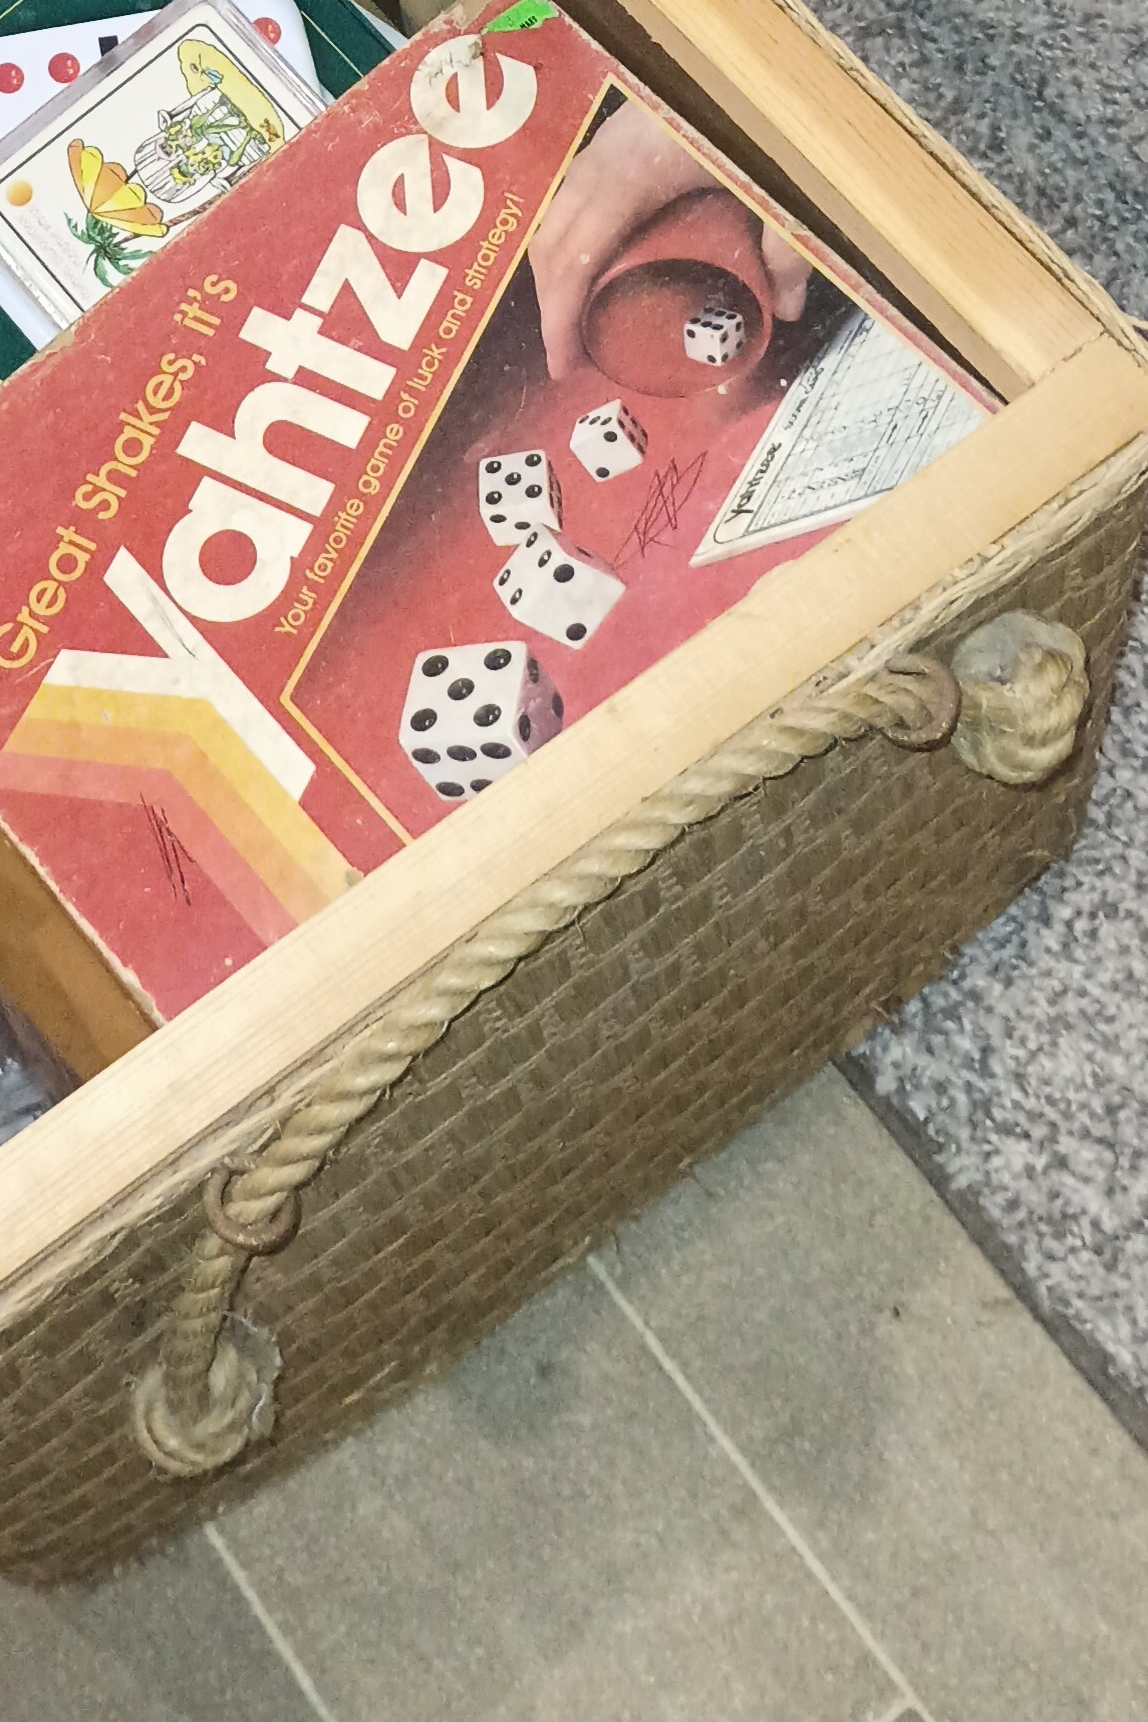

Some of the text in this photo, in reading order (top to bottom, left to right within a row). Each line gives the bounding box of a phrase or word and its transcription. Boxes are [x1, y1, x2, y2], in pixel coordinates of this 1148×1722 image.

[42, 33, 539, 802] Yahtzee
[73, 350, 208, 520] Shakes,
[172, 273, 240, 338] it's
[274, 191, 525, 636] Your favorite game of luck and strategy!
